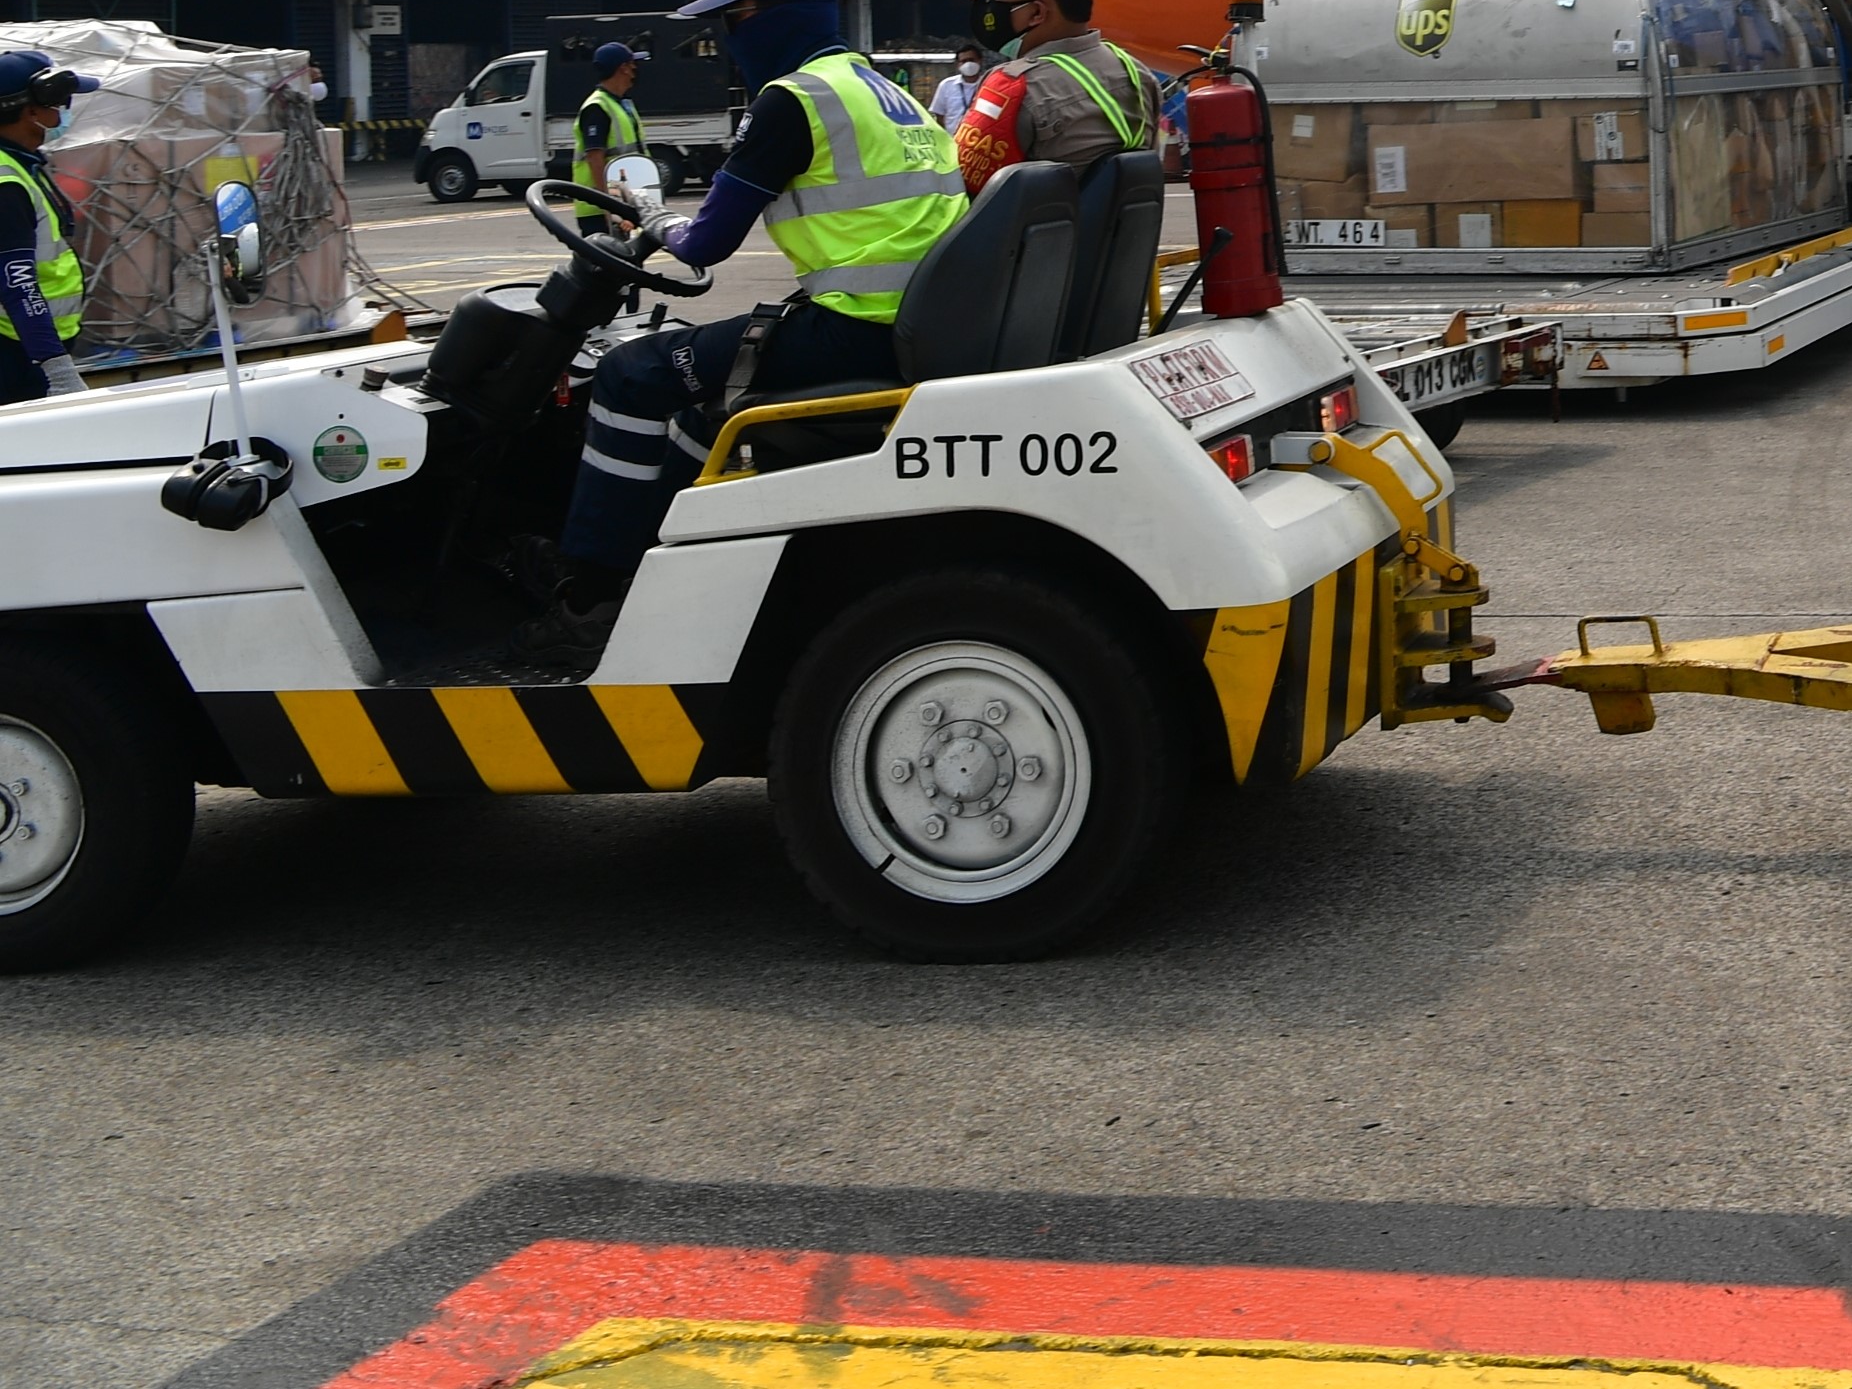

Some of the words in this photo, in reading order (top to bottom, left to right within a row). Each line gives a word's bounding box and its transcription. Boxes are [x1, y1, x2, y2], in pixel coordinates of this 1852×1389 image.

[1399, 9, 1451, 46] ups
[1337, 220, 1382, 245] 464
[1449, 348, 1476, 389] CGK
[895, 434, 1004, 479] BTT
[1019, 431, 1119, 477] 002
